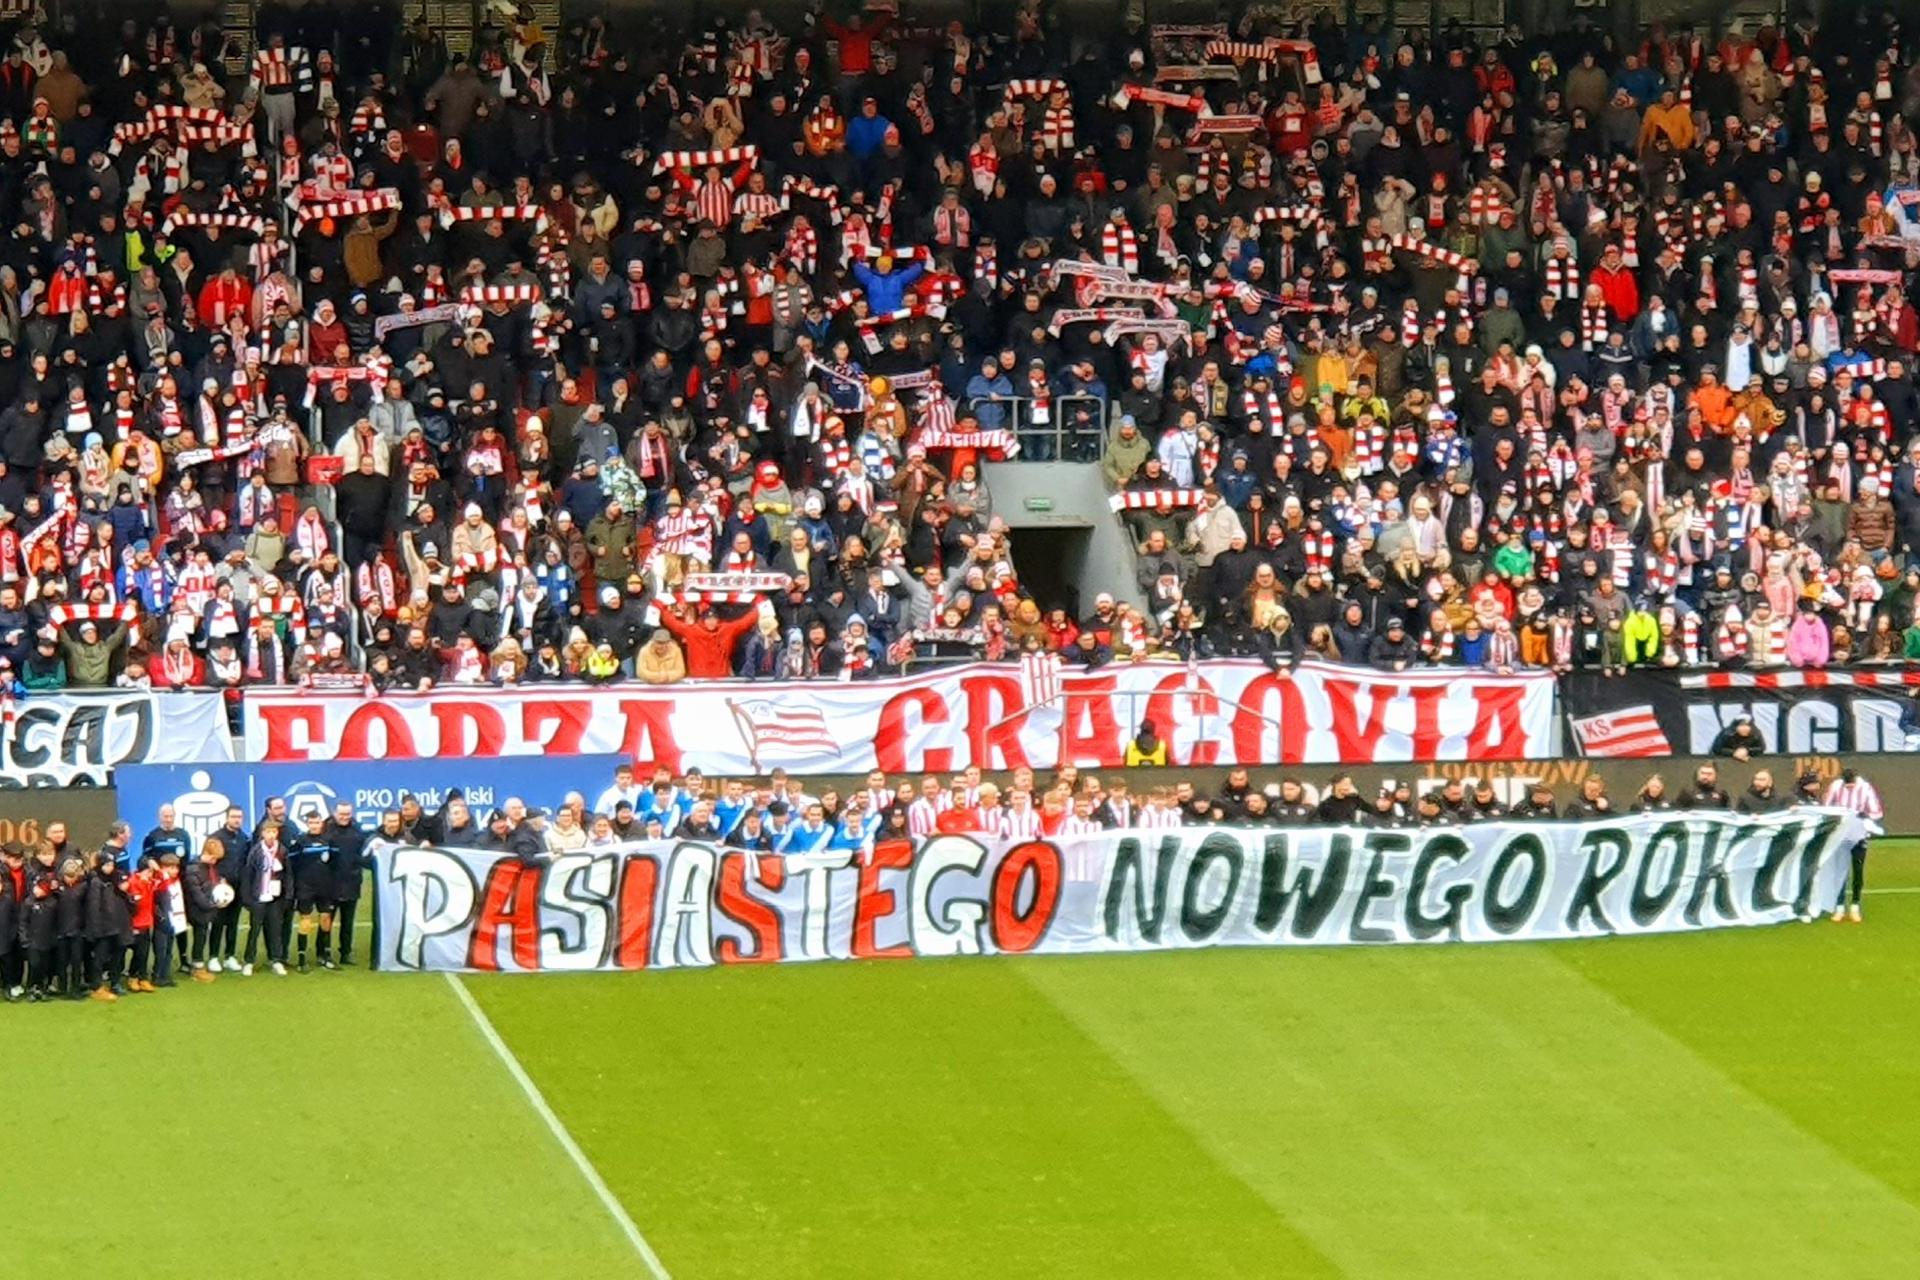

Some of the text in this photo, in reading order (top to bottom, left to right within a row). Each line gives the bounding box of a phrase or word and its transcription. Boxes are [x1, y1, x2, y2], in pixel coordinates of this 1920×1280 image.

[259, 669, 1530, 777] FORZA CRACOVIA
[1583, 718, 1612, 739] KS
[356, 789, 394, 807] PKO
[391, 814, 1841, 969] PASIASTEGO NOWEGO ROKU
